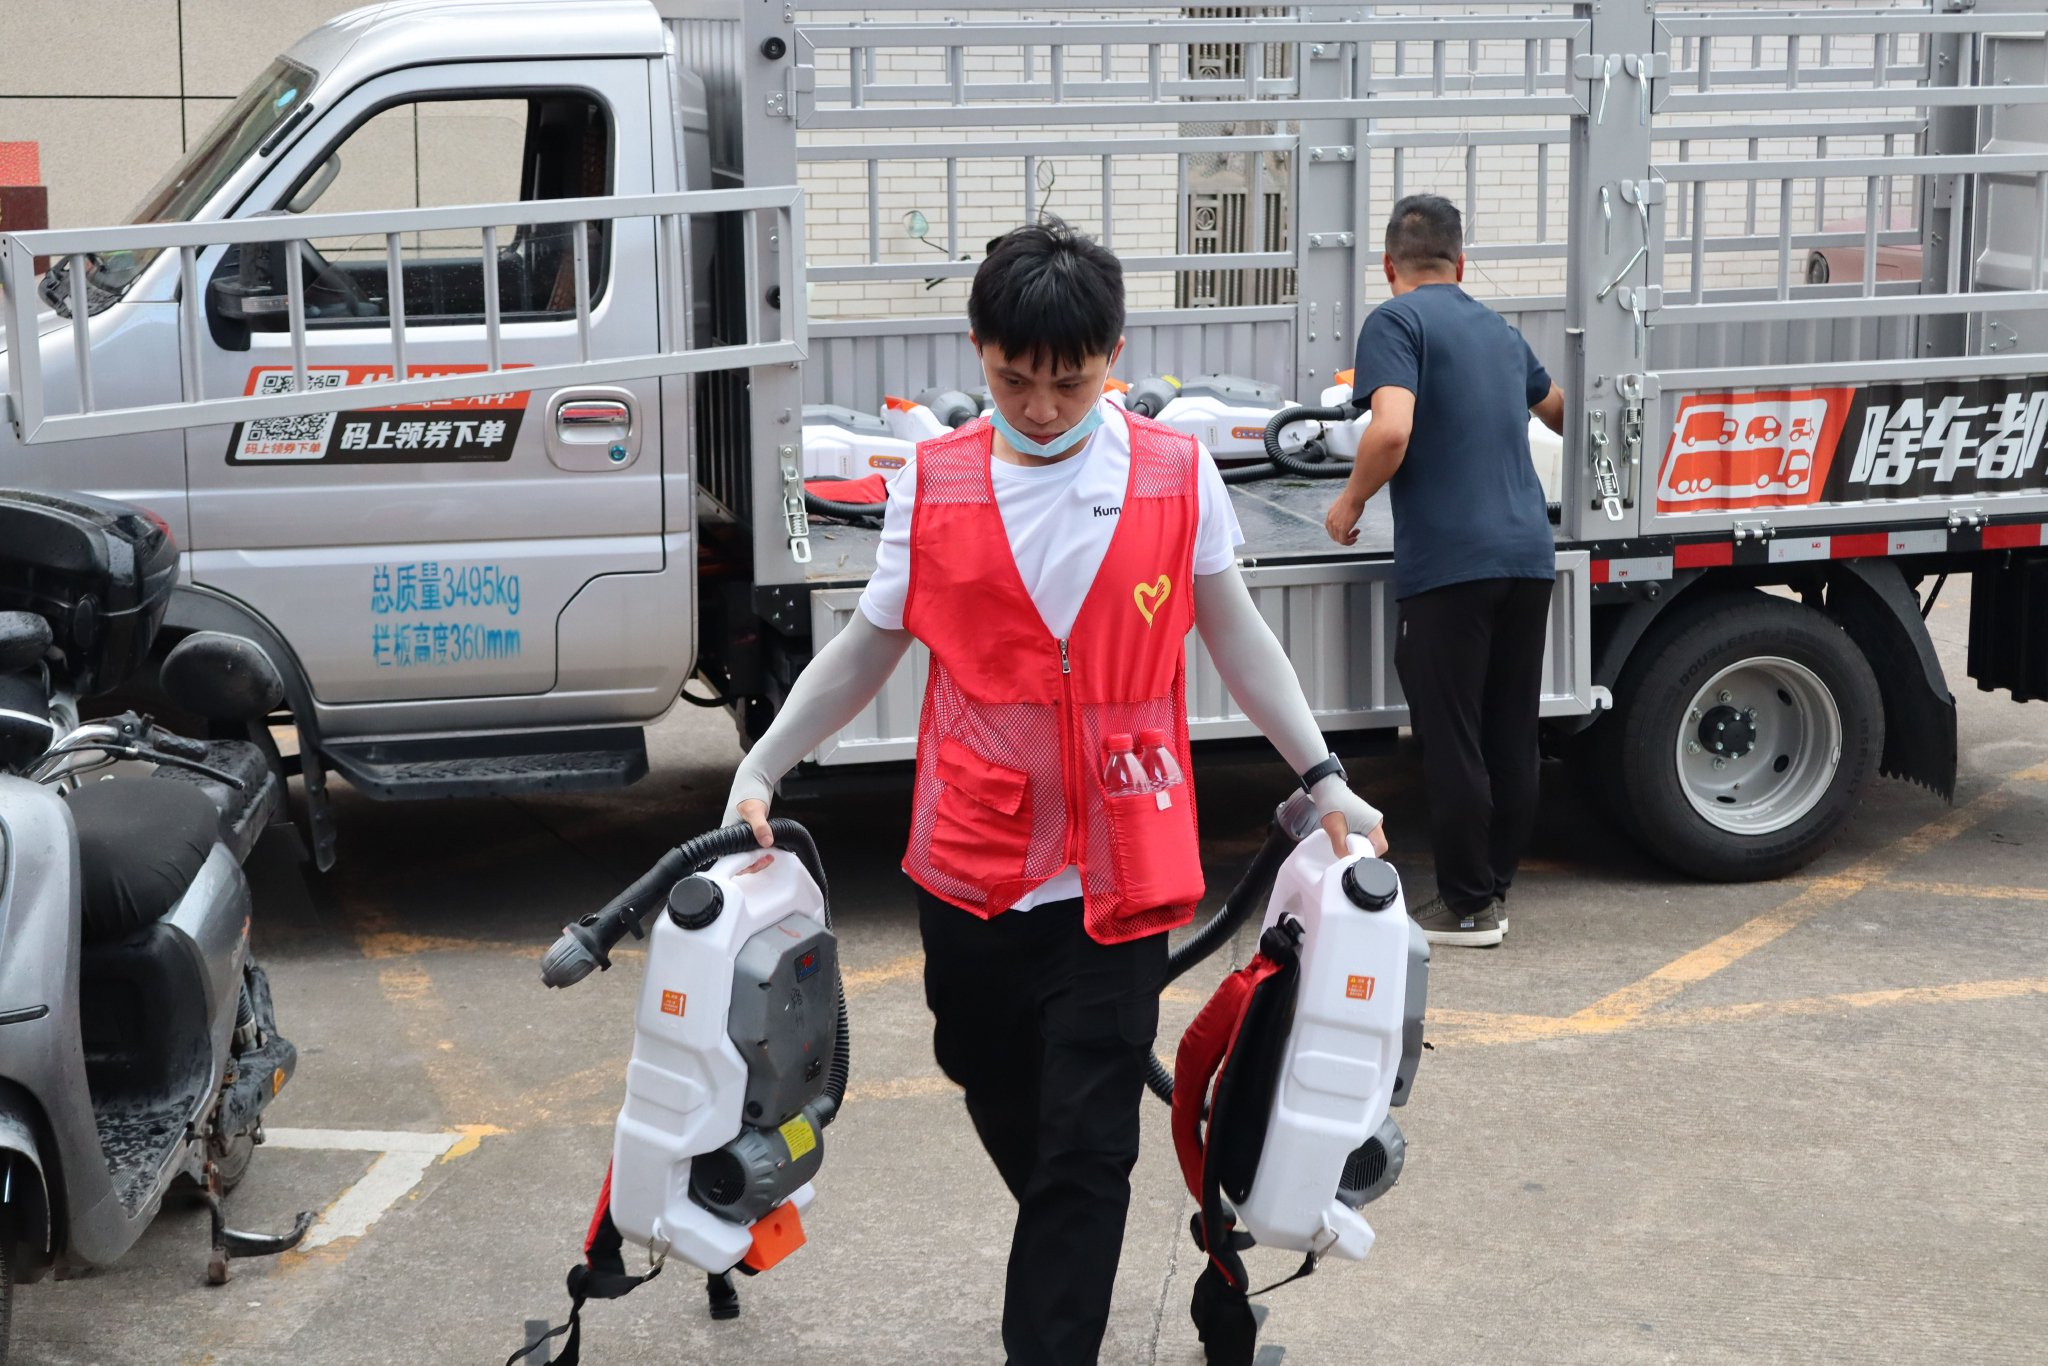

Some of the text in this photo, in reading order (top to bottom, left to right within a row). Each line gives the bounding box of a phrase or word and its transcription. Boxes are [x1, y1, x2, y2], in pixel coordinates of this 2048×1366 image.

[341, 420, 506, 450] 码上领券下单
[1848, 391, 2048, 485] 啥车都
[371, 562, 520, 615] 总质量3495kg
[372, 621, 521, 667] 栏板高度360mm
[1679, 629, 1781, 687] DOUBLEST
